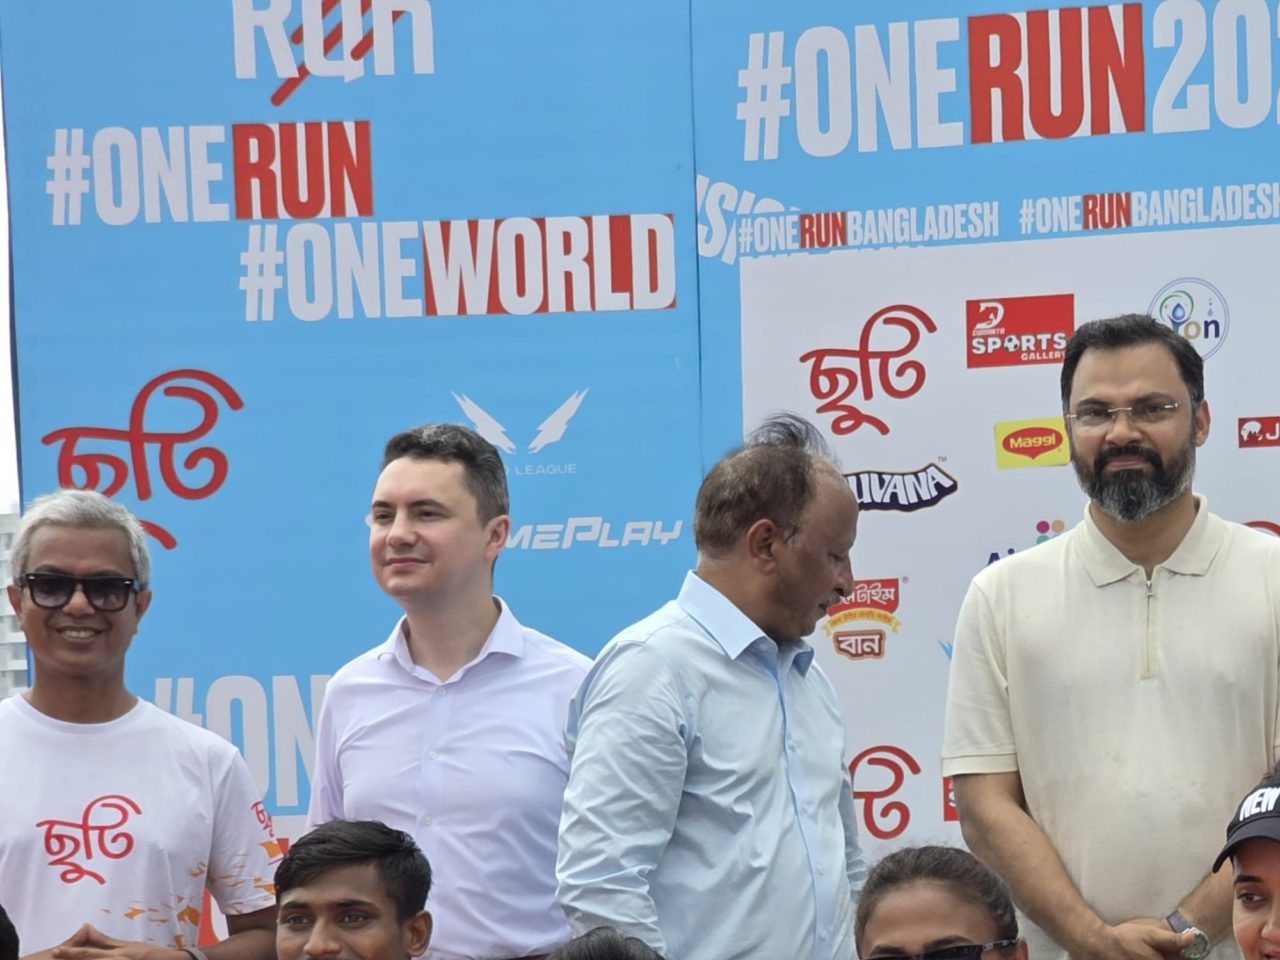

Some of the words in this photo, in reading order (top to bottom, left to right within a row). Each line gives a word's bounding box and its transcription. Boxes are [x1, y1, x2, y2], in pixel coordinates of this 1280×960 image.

[46, 120, 373, 225] #ONERUN
[739, 201, 998, 253] #ONERUNBANGLADESH
[240, 213, 676, 321] #ONEWORLD
[1009, 433, 1056, 449] Maggi
[515, 463, 578, 476] LEAGUE
[847, 465, 954, 505] UVANA
[505, 516, 684, 550] MEPLAY
